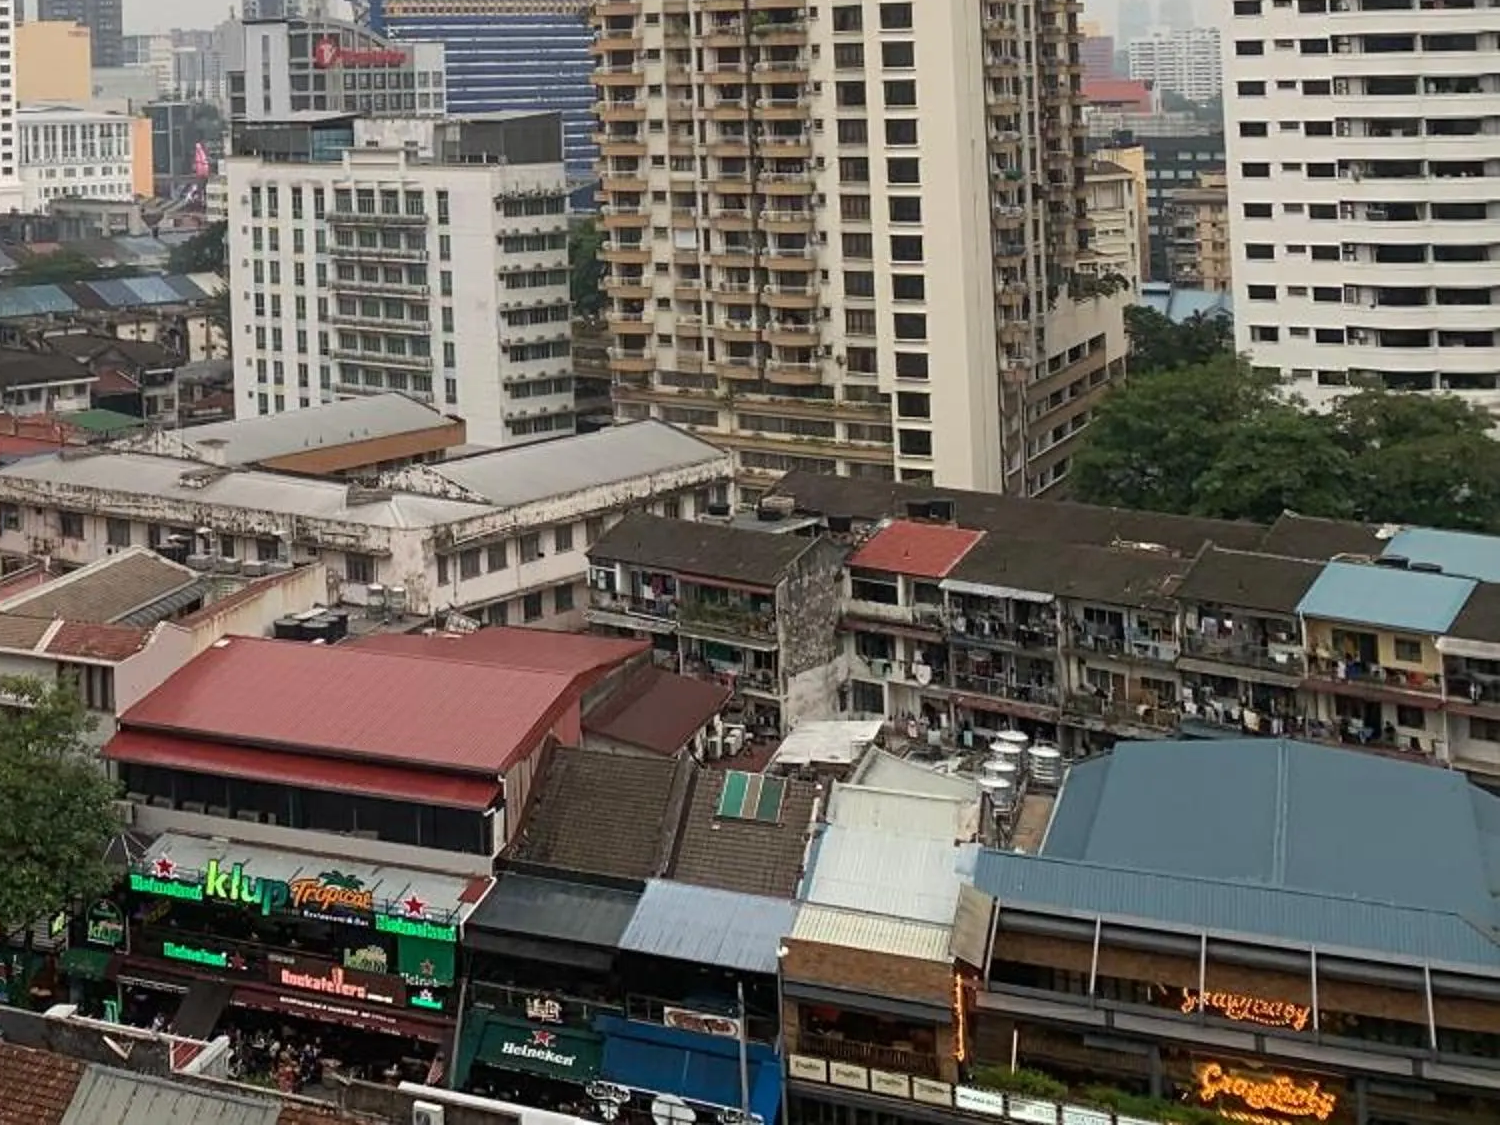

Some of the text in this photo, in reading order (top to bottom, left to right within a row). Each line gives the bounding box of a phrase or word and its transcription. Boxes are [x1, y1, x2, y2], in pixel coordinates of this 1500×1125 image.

[205, 858, 289, 916] klup
[291, 877, 374, 910] Tropical
[501, 1042, 577, 1066] Heineken
